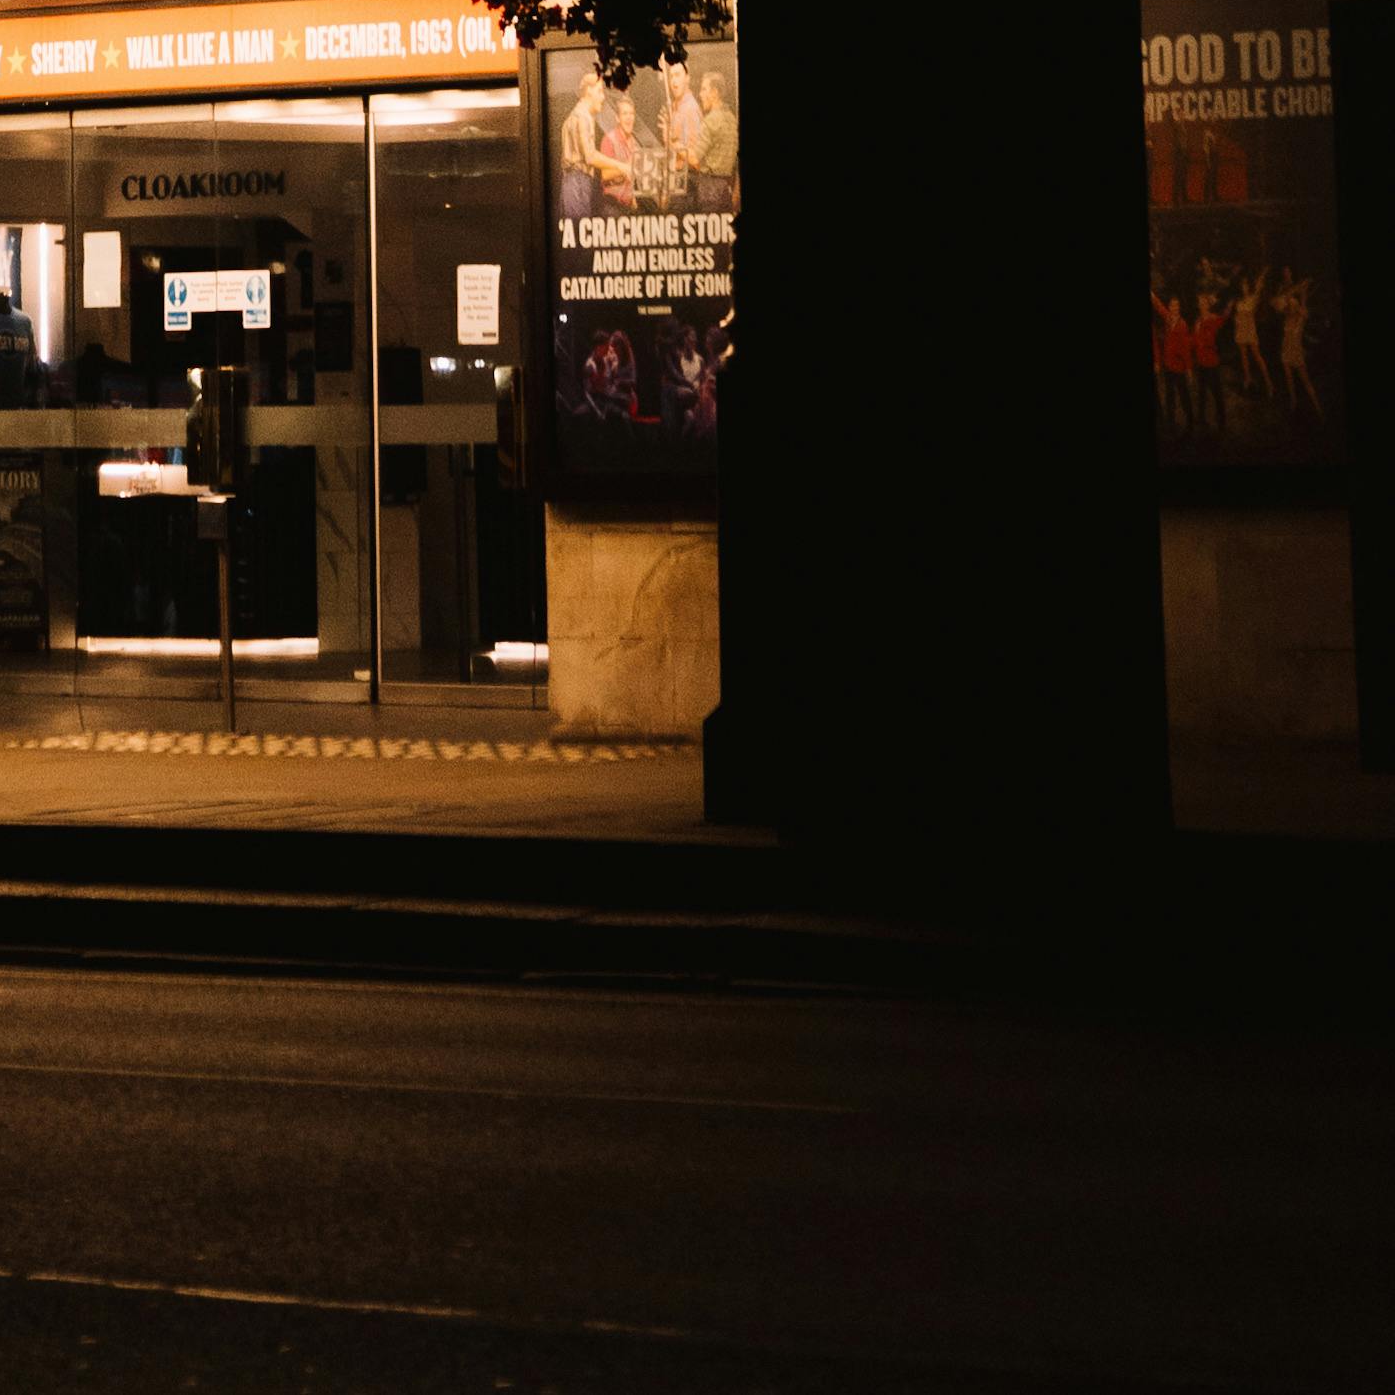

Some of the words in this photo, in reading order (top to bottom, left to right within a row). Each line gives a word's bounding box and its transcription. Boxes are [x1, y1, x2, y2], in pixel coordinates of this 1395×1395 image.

[31, 39, 98, 76] SHERRY
[125, 34, 175, 70] WALK
[176, 31, 216, 67] LIKE
[218, 30, 231, 64] A
[233, 28, 274, 63] MAN
[305, 21, 406, 60] DECEMBER,
[410, 17, 454, 55] 1963
[457, 14, 497, 58] (OH,
[1233, 30, 1281, 81] TO
[1272, 82, 1335, 119] CHOR
[121, 169, 286, 202] CLOAKROOM
[579, 216, 679, 247] CRACKING
[683, 213, 735, 245] STOR
[592, 249, 624, 274] AND
[625, 248, 647, 273] AN
[648, 246, 715, 272] ENDLESS
[560, 275, 643, 301] CATALOGUE
[645, 274, 666, 299] OF
[667, 273, 693, 297] HIT
